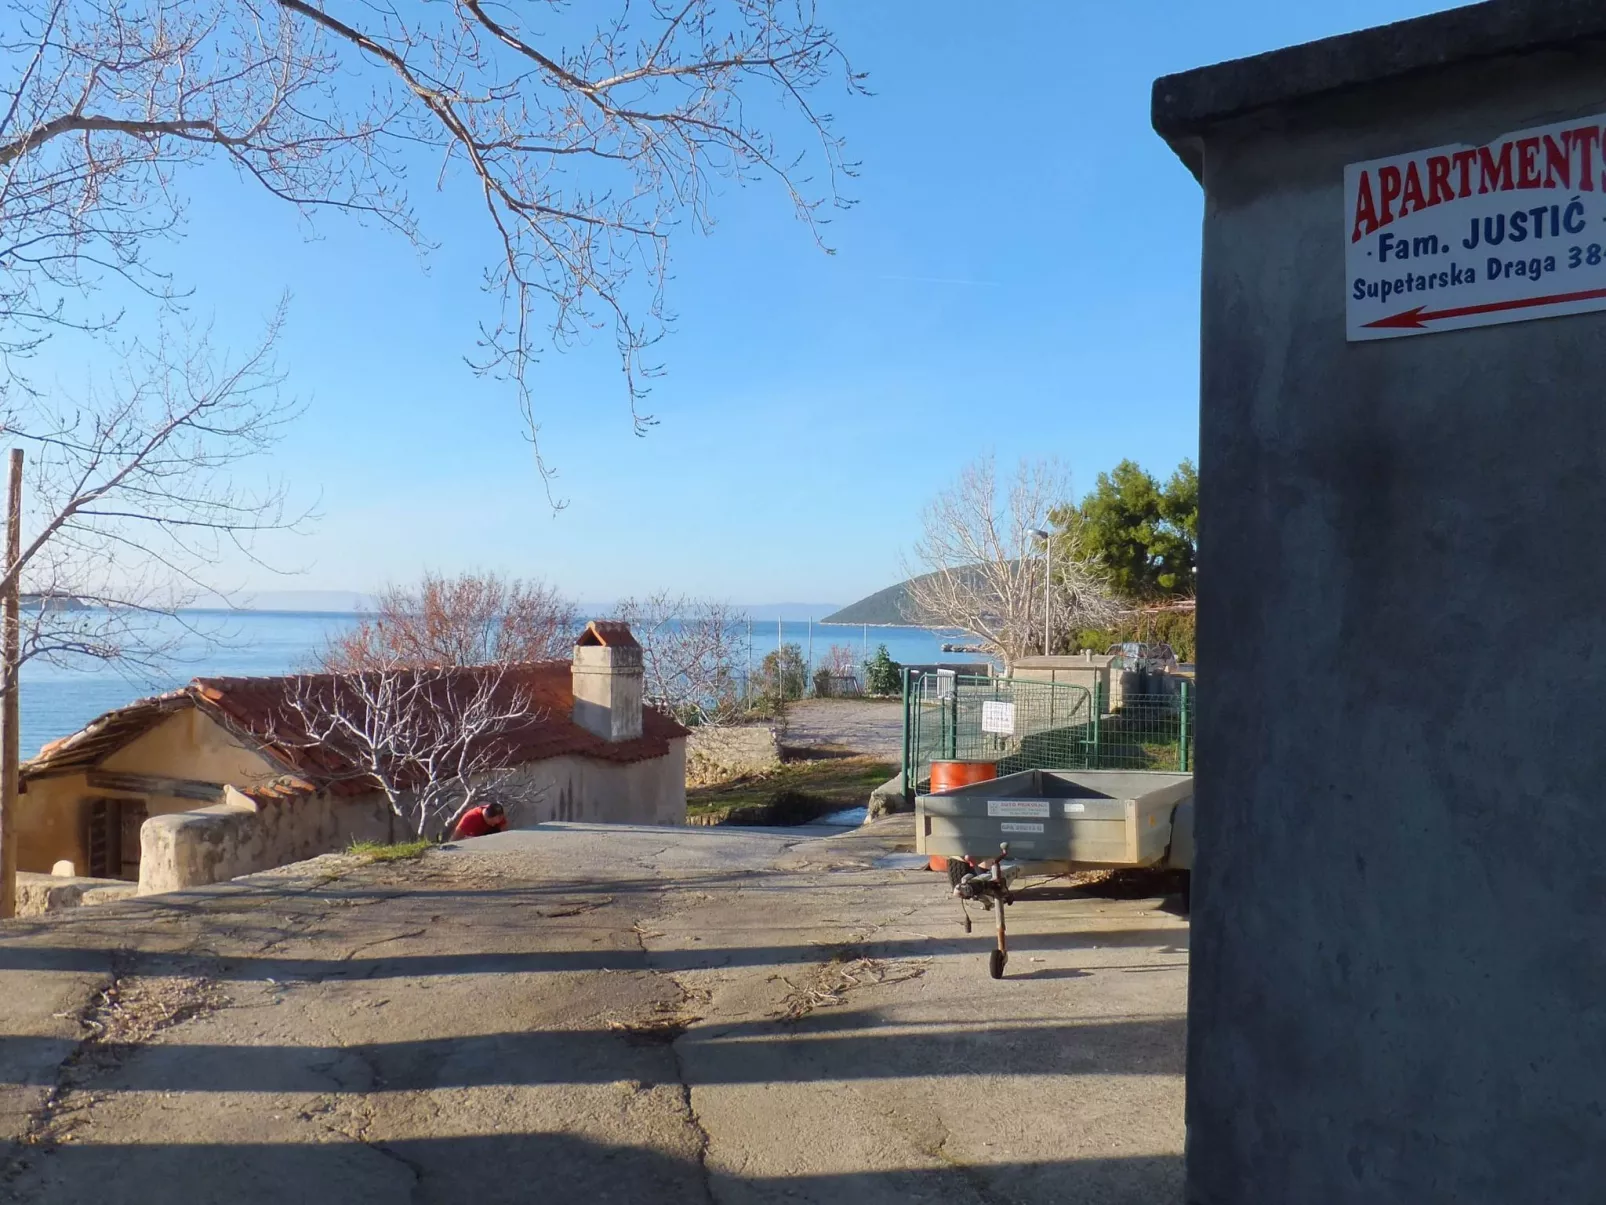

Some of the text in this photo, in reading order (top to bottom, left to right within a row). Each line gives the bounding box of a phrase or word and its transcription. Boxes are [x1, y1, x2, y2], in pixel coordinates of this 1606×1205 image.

[1379, 195, 1586, 262] Fam. JUSTIĆ
[1353, 243, 1606, 302] Supetarska Draga 38
